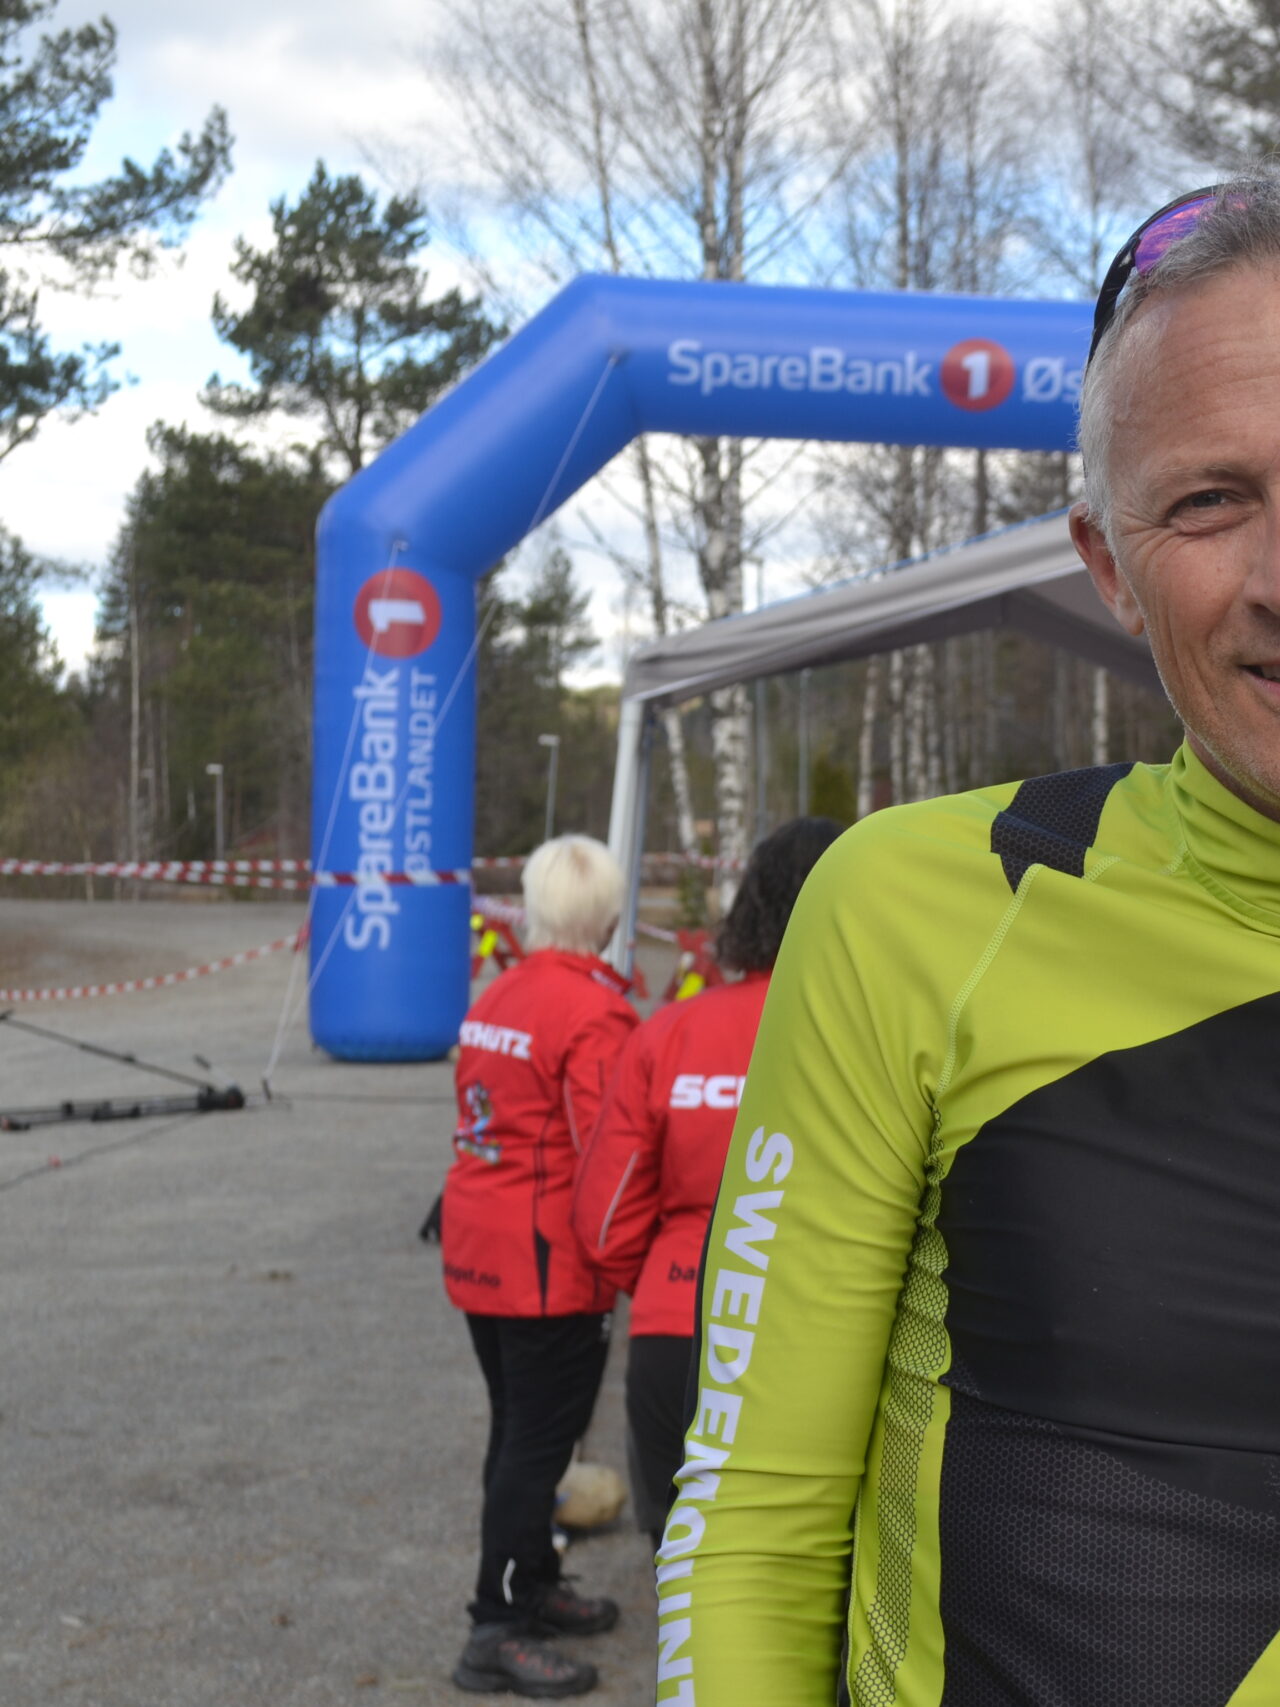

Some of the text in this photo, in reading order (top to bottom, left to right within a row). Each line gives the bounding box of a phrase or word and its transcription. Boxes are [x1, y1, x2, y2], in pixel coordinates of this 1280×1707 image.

[667, 339, 934, 398] SpareBank
[960, 349, 991, 400] 1
[344, 598, 427, 951] SpareBank 1
